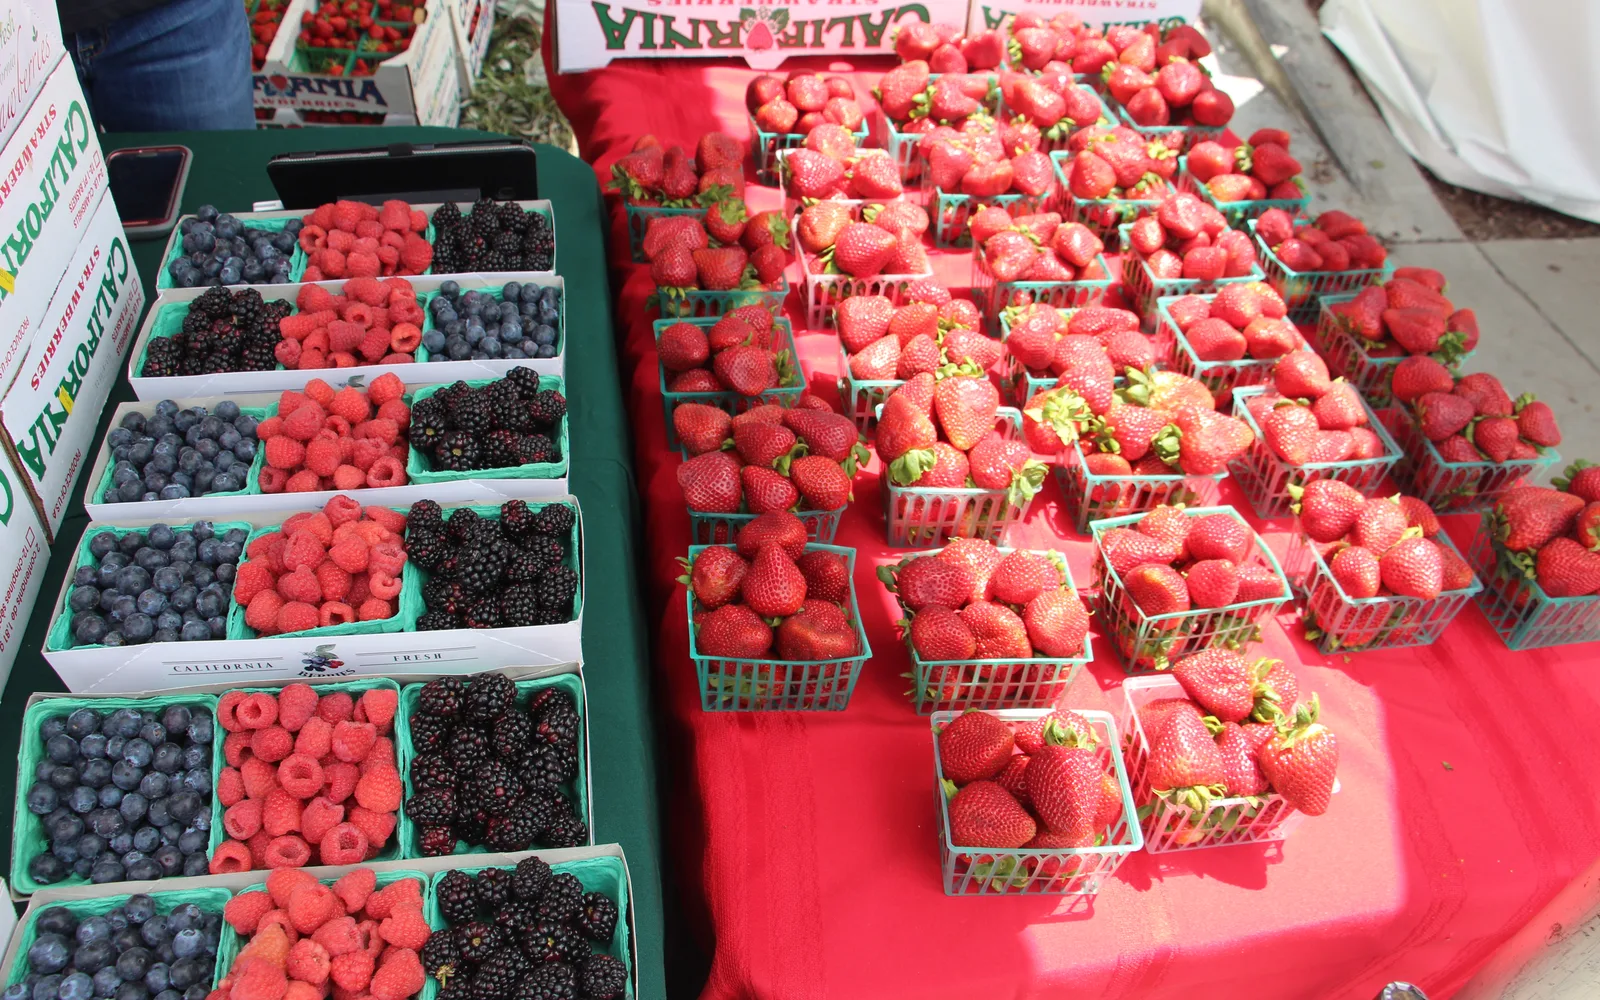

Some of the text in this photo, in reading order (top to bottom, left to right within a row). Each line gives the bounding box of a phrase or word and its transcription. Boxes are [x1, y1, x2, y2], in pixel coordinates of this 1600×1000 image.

[0, 25, 50, 132] awberries
[31, 245, 100, 391] STRAWBERRIES
[65, 448, 81, 488] PRODUCE
[16, 551, 37, 605] contenants
[173, 653, 443, 673] CALIFORNIA FRESH
